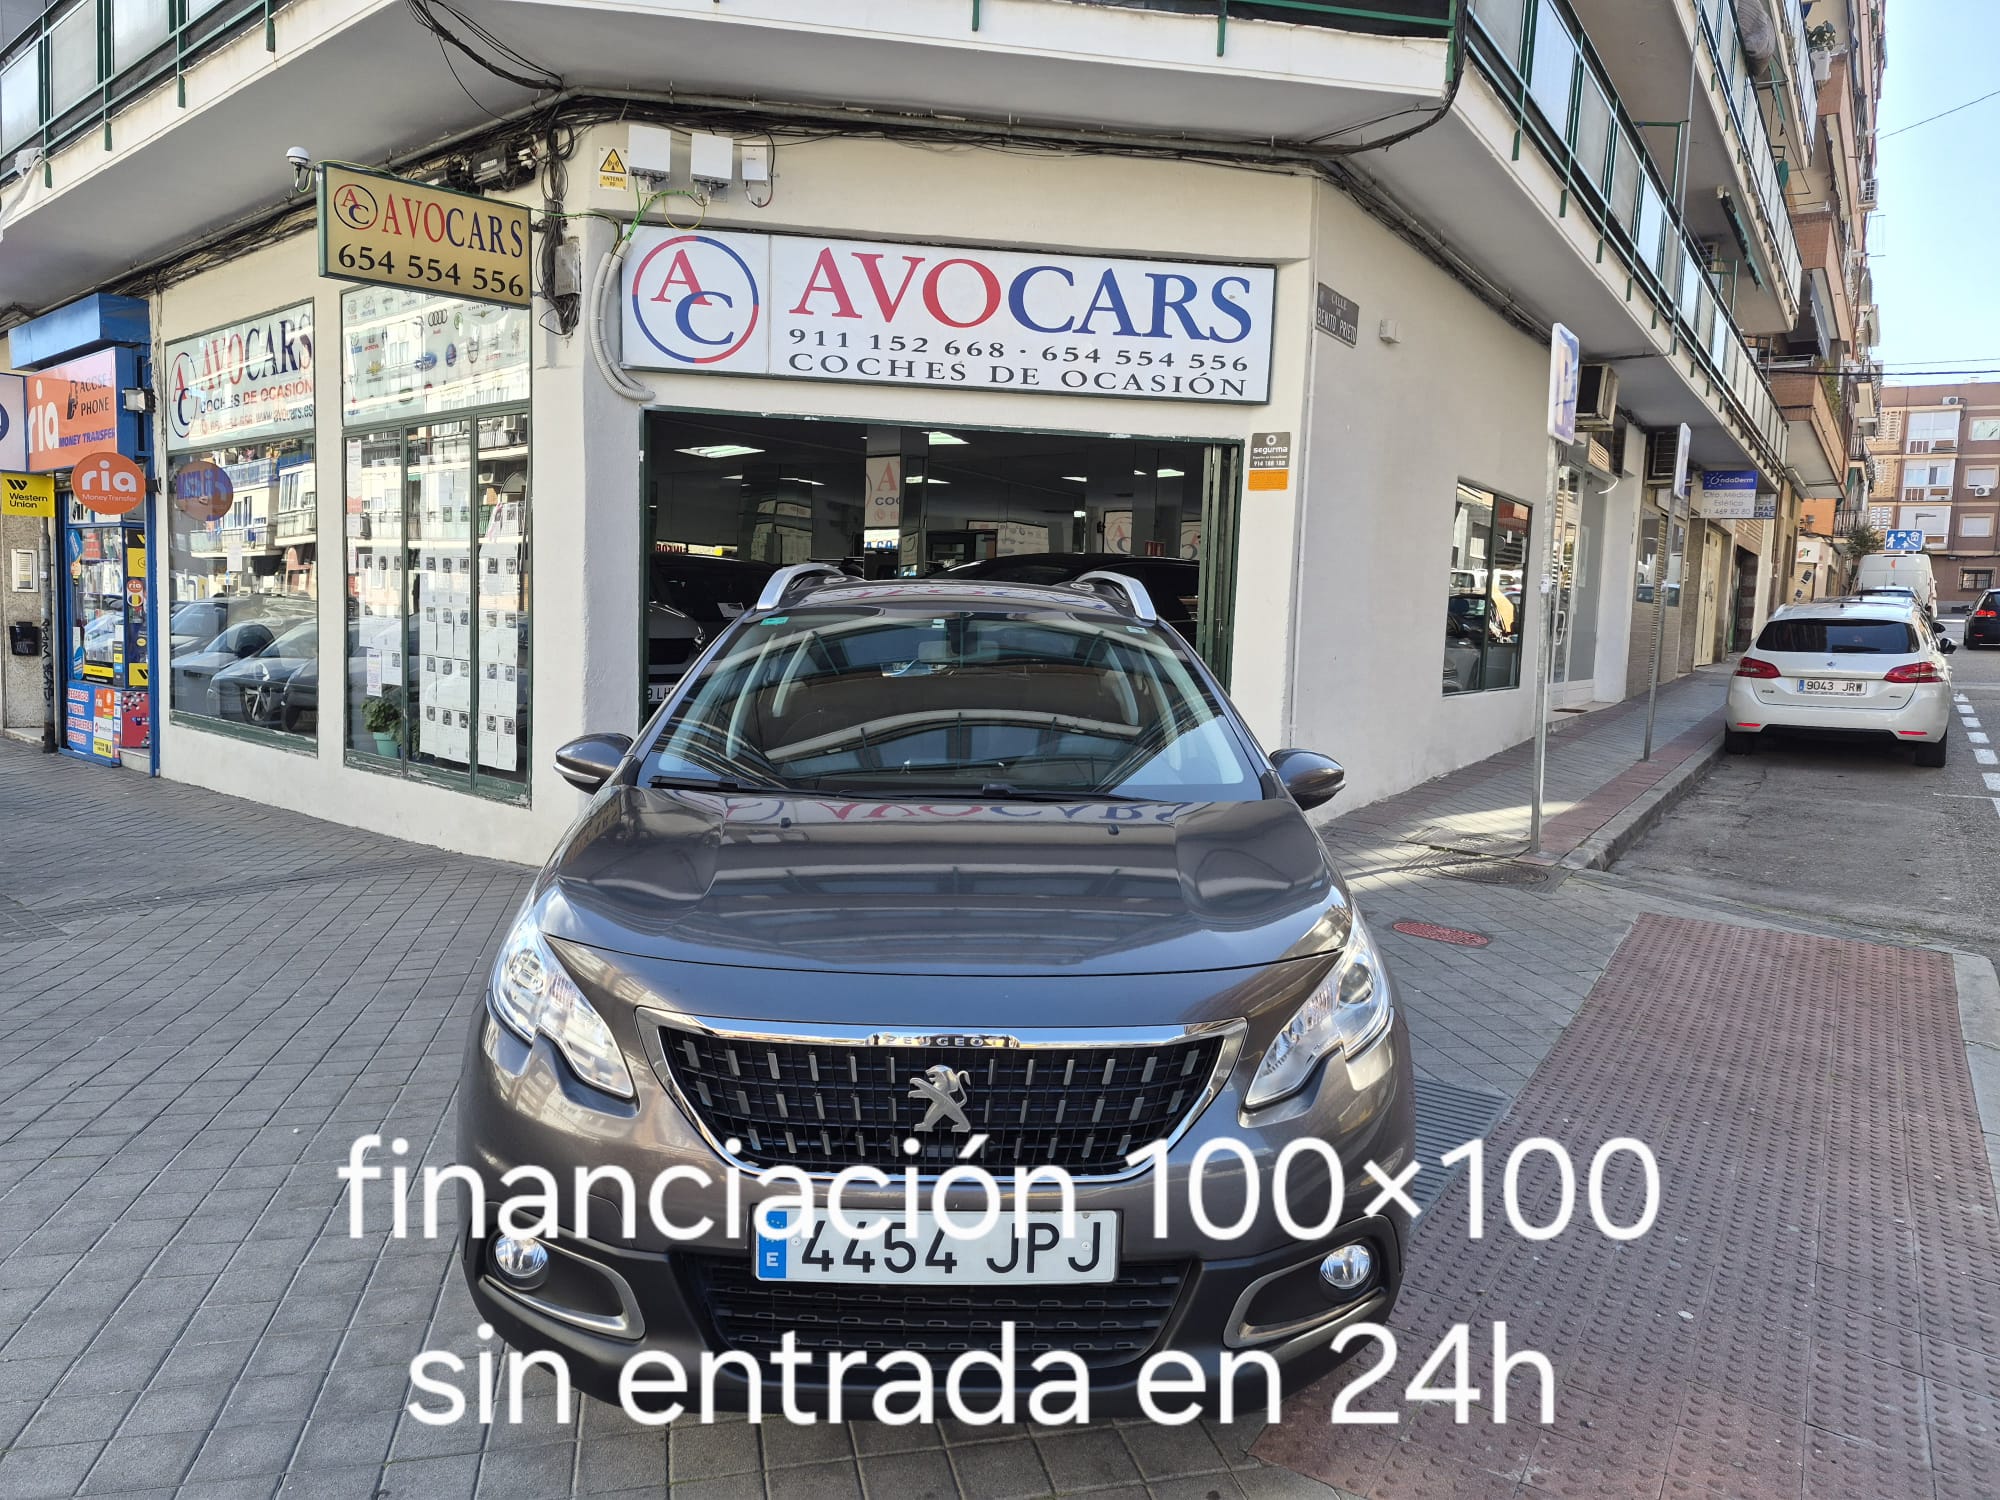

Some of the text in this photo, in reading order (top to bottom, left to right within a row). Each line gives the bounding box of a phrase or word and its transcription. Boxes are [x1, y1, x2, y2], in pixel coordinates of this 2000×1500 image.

[382, 193, 523, 258] AVOCARS
[338, 243, 524, 297] 654 554 556
[788, 246, 1252, 344] AVOCARS
[1317, 307, 1357, 345] BENITO PRIETO
[200, 312, 313, 392] AVOCARS
[788, 328, 1248, 372] 911 152 668 654 554 556
[788, 353, 1247, 397] COCHES DE OCASIÓN
[81, 396, 110, 417] PHONE
[242, 390, 257, 405] DE
[27, 379, 59, 454] ria
[58, 433, 82, 448] MONEY
[1253, 446, 1288, 455] segurma
[81, 460, 137, 493] ria
[9, 492, 48, 503] Western
[9, 500, 38, 509] Union
[82, 493, 108, 502] Money
[1806, 680, 1863, 692] 9043 JRW
[765, 1252, 780, 1268] E
[801, 1220, 1101, 1274] 4454 JPJ
